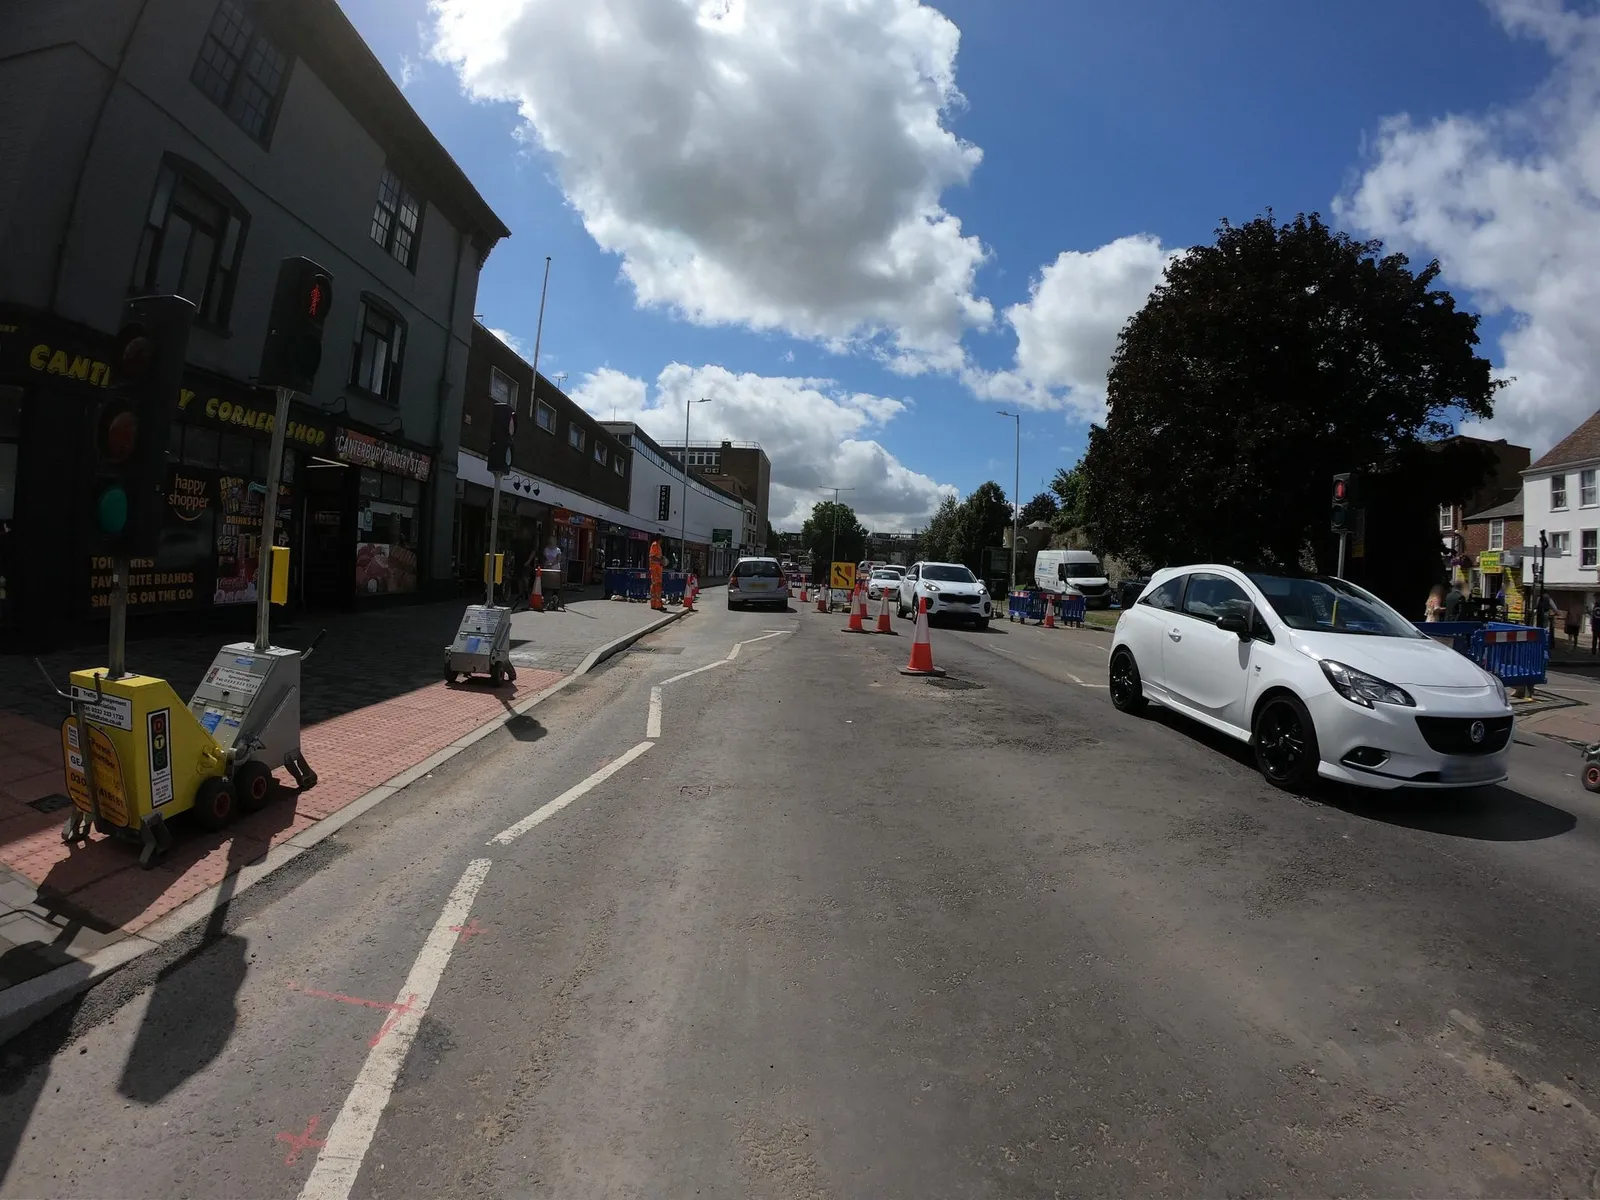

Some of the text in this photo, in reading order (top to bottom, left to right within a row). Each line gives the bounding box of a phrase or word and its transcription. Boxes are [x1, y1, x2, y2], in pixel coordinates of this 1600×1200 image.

[205, 397, 276, 433] CORNER
[286, 420, 326, 446] SHOP
[338, 436, 385, 463] CANTERBURY
[175, 473, 207, 495] happy
[168, 490, 210, 511] shopper
[154, 572, 195, 585] BRANDS
[140, 590, 156, 603] ON
[157, 589, 177, 602] THE
[178, 588, 194, 600] GO
